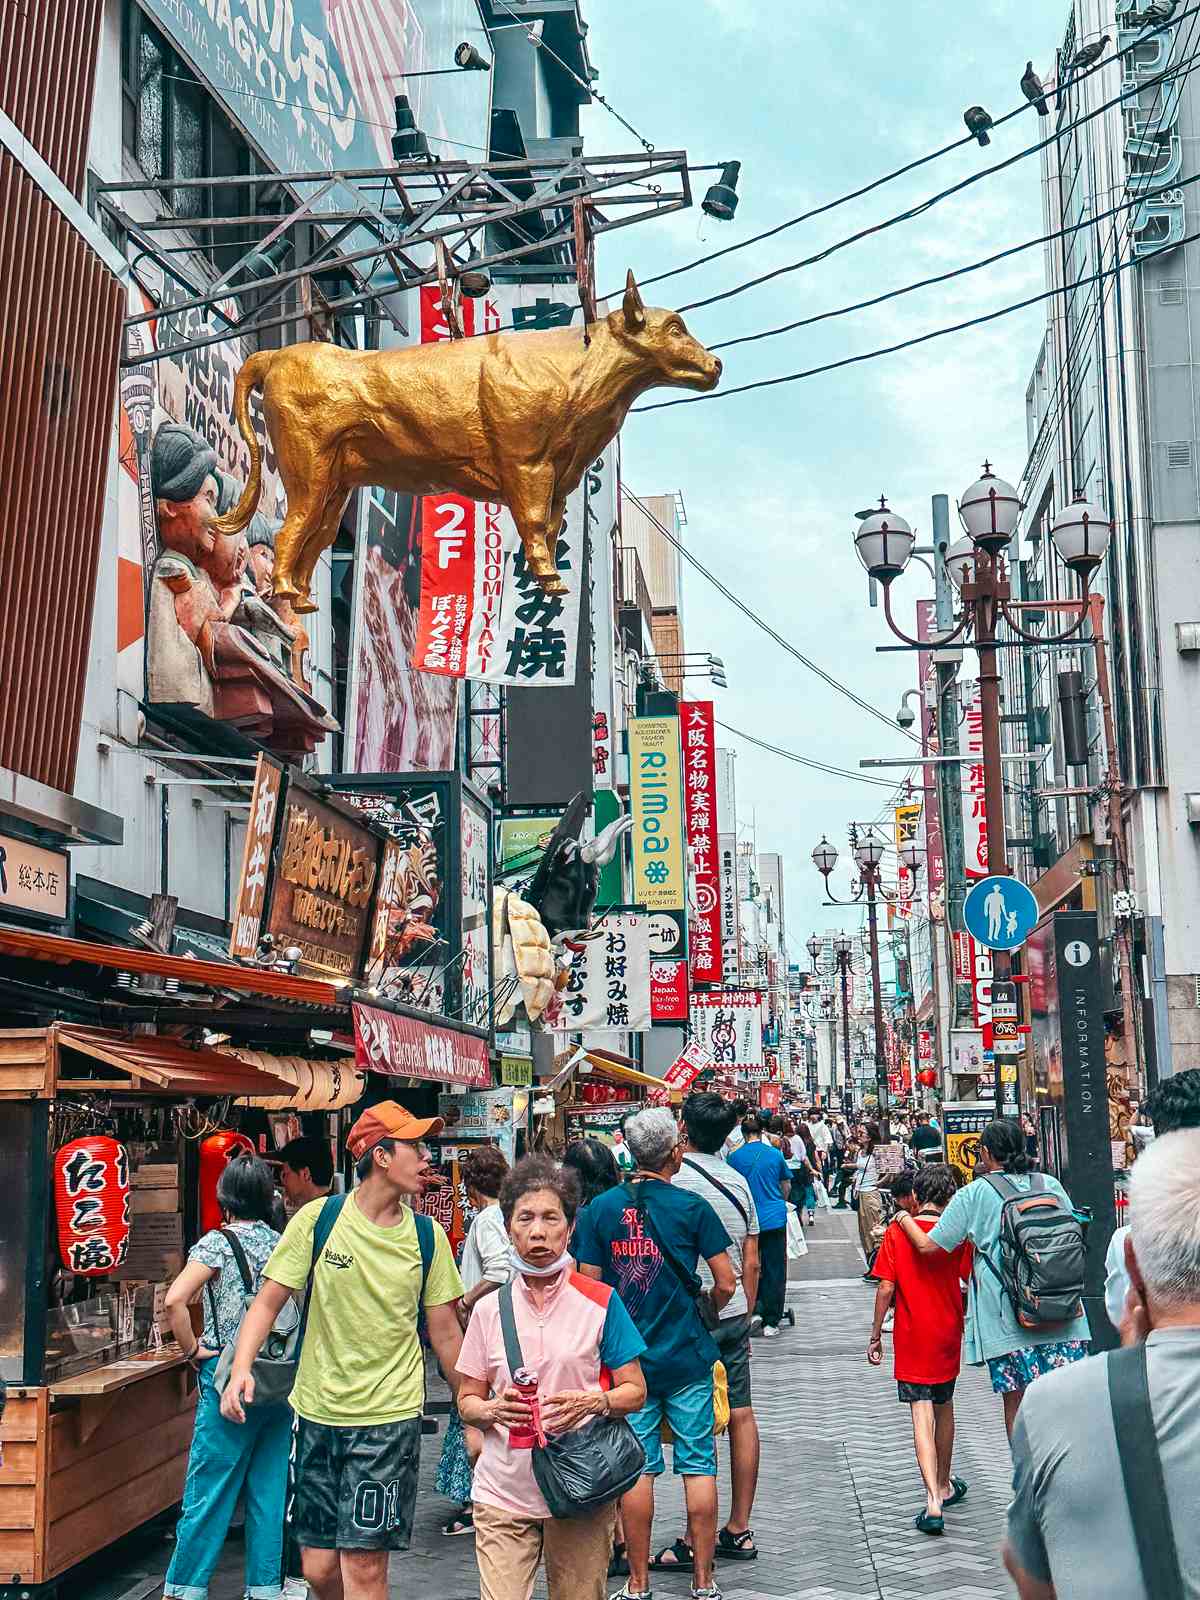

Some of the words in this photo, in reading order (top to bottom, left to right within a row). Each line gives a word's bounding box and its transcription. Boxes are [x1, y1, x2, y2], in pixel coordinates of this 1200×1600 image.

[433, 502, 468, 570] 2F
[641, 751, 668, 854] Rilmoa
[687, 706, 716, 876] 大阪名物実弾禁止
[18, 863, 60, 896] 総本店
[605, 931, 630, 1026] お好み焼
[1074, 988, 1093, 1113] INFORMATION
[63, 1150, 115, 1273] たこ焼
[353, 1480, 400, 1530] 01
